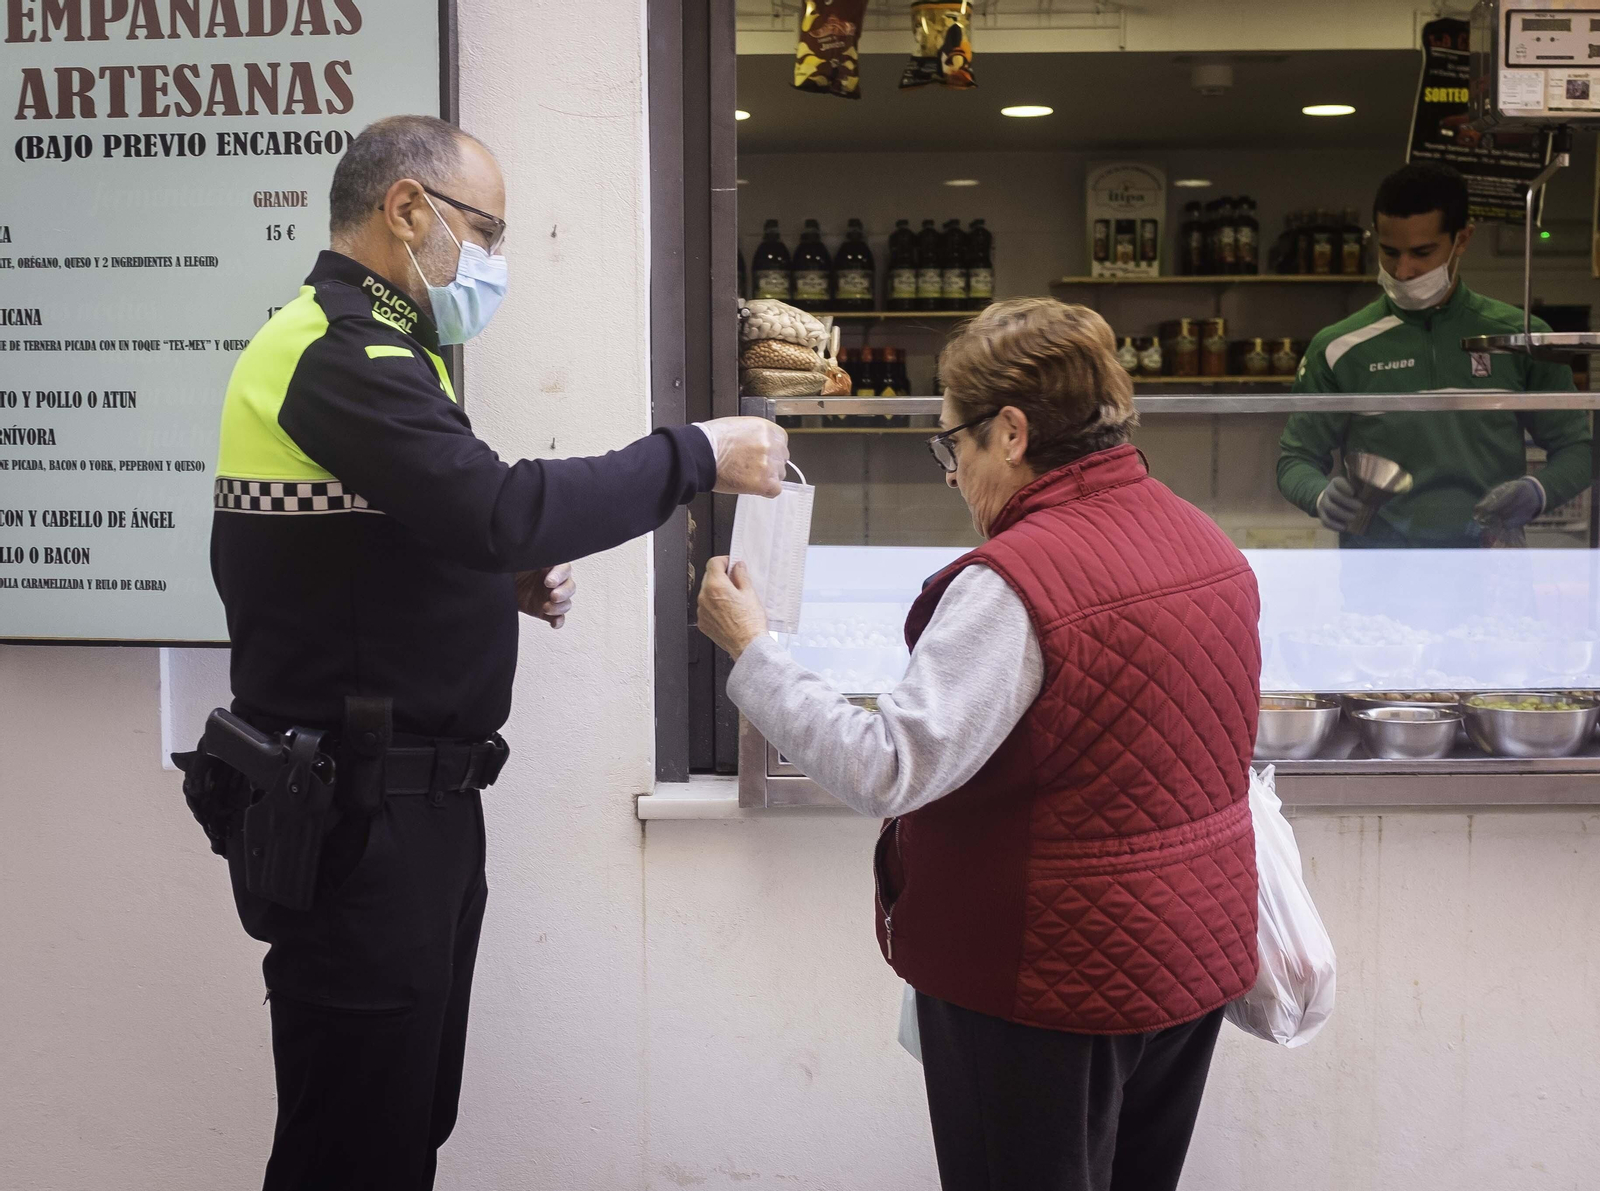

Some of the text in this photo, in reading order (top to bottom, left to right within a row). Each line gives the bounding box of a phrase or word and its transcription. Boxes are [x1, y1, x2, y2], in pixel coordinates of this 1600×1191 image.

[4, 0, 363, 43] EMPANADAS
[14, 60, 354, 120] ARTESANAS
[1424, 87, 1469, 103] SORTEO
[15, 130, 354, 162] (BAJO PREVIO ENCARGO)
[253, 191, 308, 208] GRANDE
[266, 224, 295, 241] 15 €
[0, 255, 218, 269] TE, ORÉGANO, QUESO Y 2 INGREDIENTES A ELEGIR)
[362, 275, 418, 323] POLICIA
[0, 309, 42, 326] ICANA
[373, 301, 412, 334] LOCAL
[9, 340, 21, 351] DE
[23, 340, 62, 351] TERNERA
[64, 340, 97, 351] PICADA
[99, 340, 116, 351] CON
[118, 340, 129, 351] UN
[132, 340, 160, 352] TOQUE
[214, 340, 220, 350] Y
[22, 391, 31, 408] Y
[36, 391, 82, 408] POLLO
[87, 391, 97, 408] O
[102, 391, 136, 408] ATUN
[11, 460, 46, 471] PICADA,
[49, 460, 77, 471] BACON
[80, 460, 86, 471] O
[89, 460, 116, 472] YORK,
[119, 460, 163, 471] PEPERONI
[166, 461, 172, 471] Y
[174, 460, 205, 472] QUESO)
[28, 510, 37, 527] Y
[42, 510, 103, 528] CABELLO
[107, 511, 126, 528] DE
[130, 508, 175, 528] ÁNGEL
[29, 547, 39, 564] O
[43, 547, 90, 564] BACON
[21, 578, 84, 589] CARAMELIZADA
[87, 579, 93, 590] Y
[95, 579, 118, 590] RULO
[120, 579, 132, 590] DE
[134, 580, 167, 592] CABRA)
